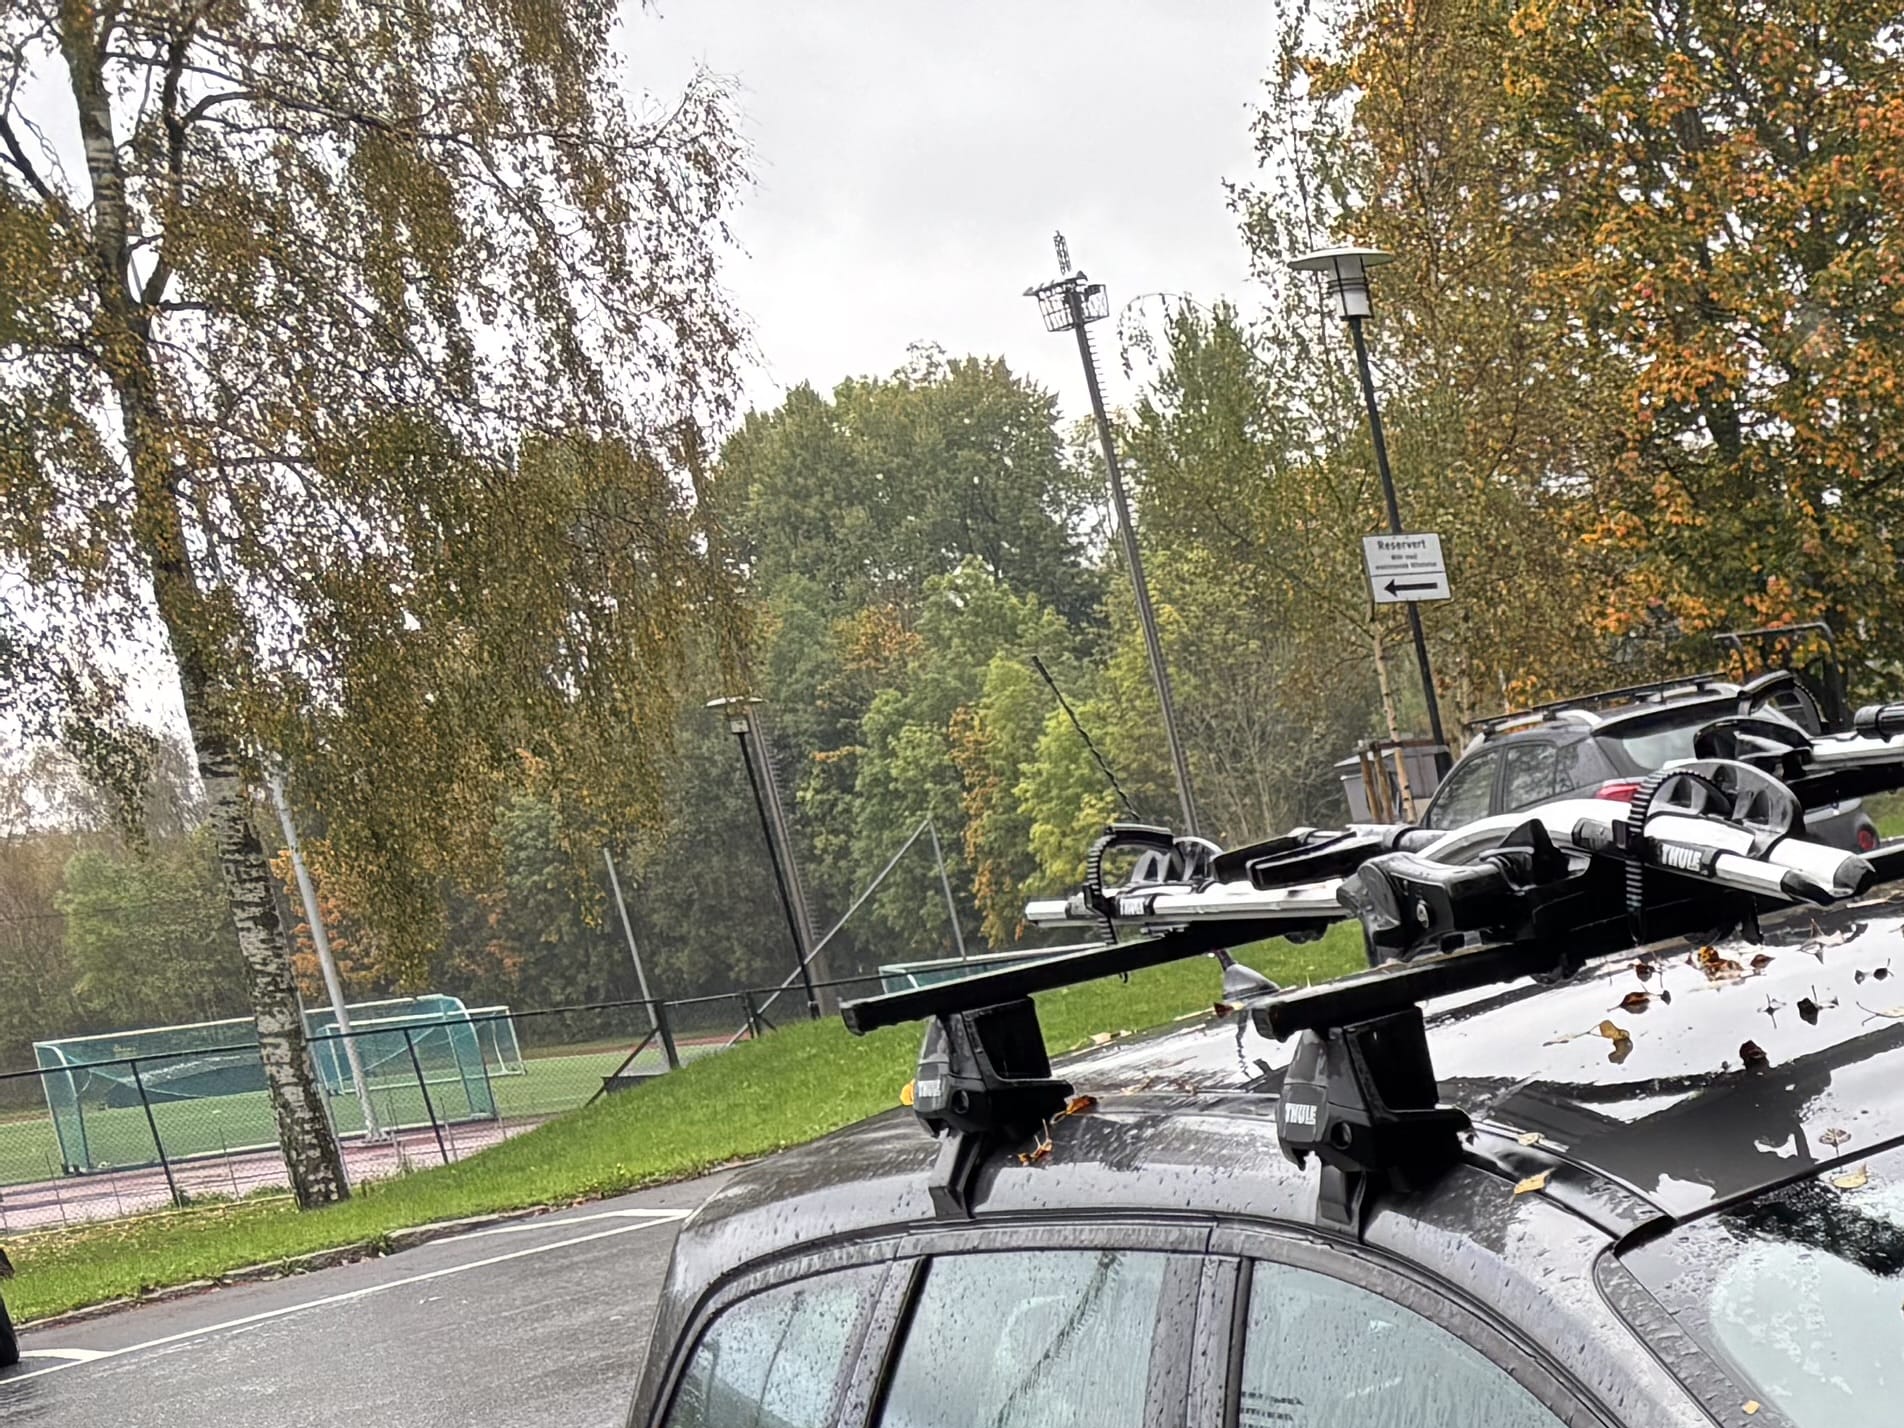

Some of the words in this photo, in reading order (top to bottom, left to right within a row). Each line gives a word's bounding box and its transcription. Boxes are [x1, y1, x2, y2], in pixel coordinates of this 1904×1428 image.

[1377, 539, 1426, 550] Reservert
[1661, 843, 1702, 872] THULE
[1120, 897, 1145, 915] THULE
[1285, 1102, 1318, 1125] THULE
